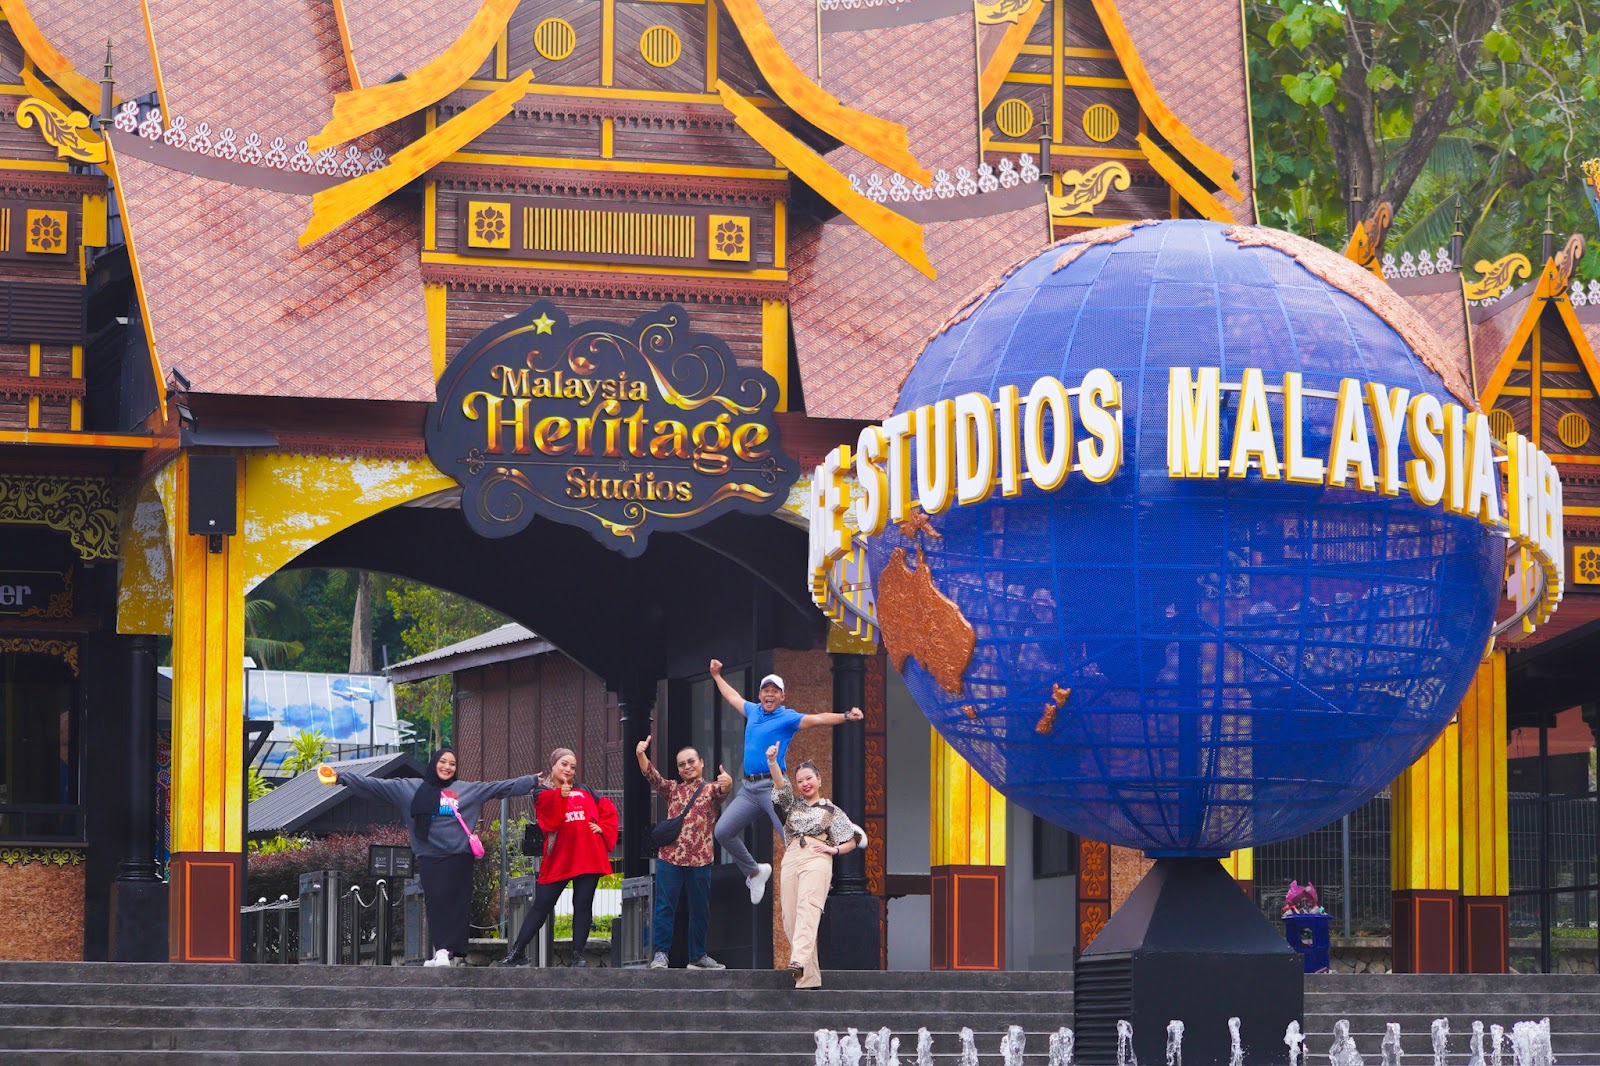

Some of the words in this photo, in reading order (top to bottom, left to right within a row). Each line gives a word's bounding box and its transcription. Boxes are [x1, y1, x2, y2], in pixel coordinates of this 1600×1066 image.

[490, 365, 650, 407] Malaysia
[462, 391, 769, 475] Heritage
[856, 367, 1122, 537] STUDIOS
[1167, 366, 1501, 527] MALAYSIA
[565, 466, 693, 501] Studios
